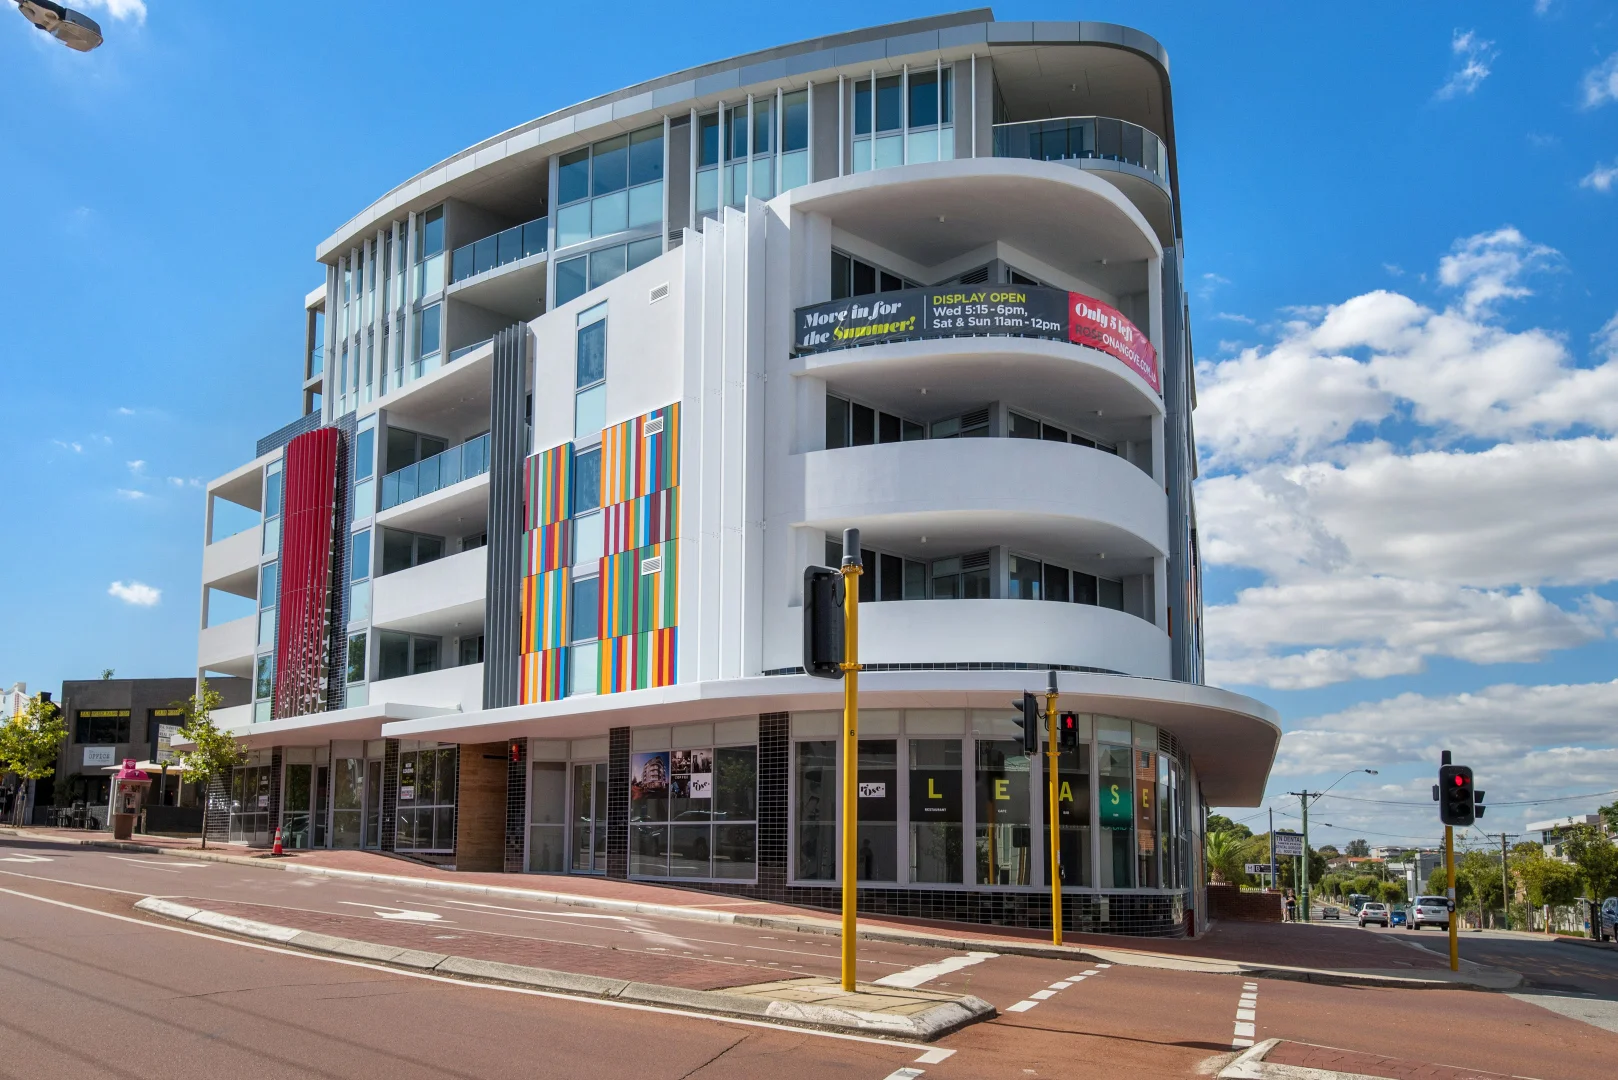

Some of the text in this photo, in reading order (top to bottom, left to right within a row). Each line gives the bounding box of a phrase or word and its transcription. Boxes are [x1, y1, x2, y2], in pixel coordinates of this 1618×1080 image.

[933, 292, 1026, 306] DISPLAY OPEN
[803, 300, 902, 329] Move in for
[933, 306, 962, 317] Wed
[1075, 302, 1133, 342] Only 5 left
[803, 315, 916, 347] the Summer!
[933, 319, 953, 329] Sat
[956, 318, 965, 327] &
[968, 317, 991, 327] Sun
